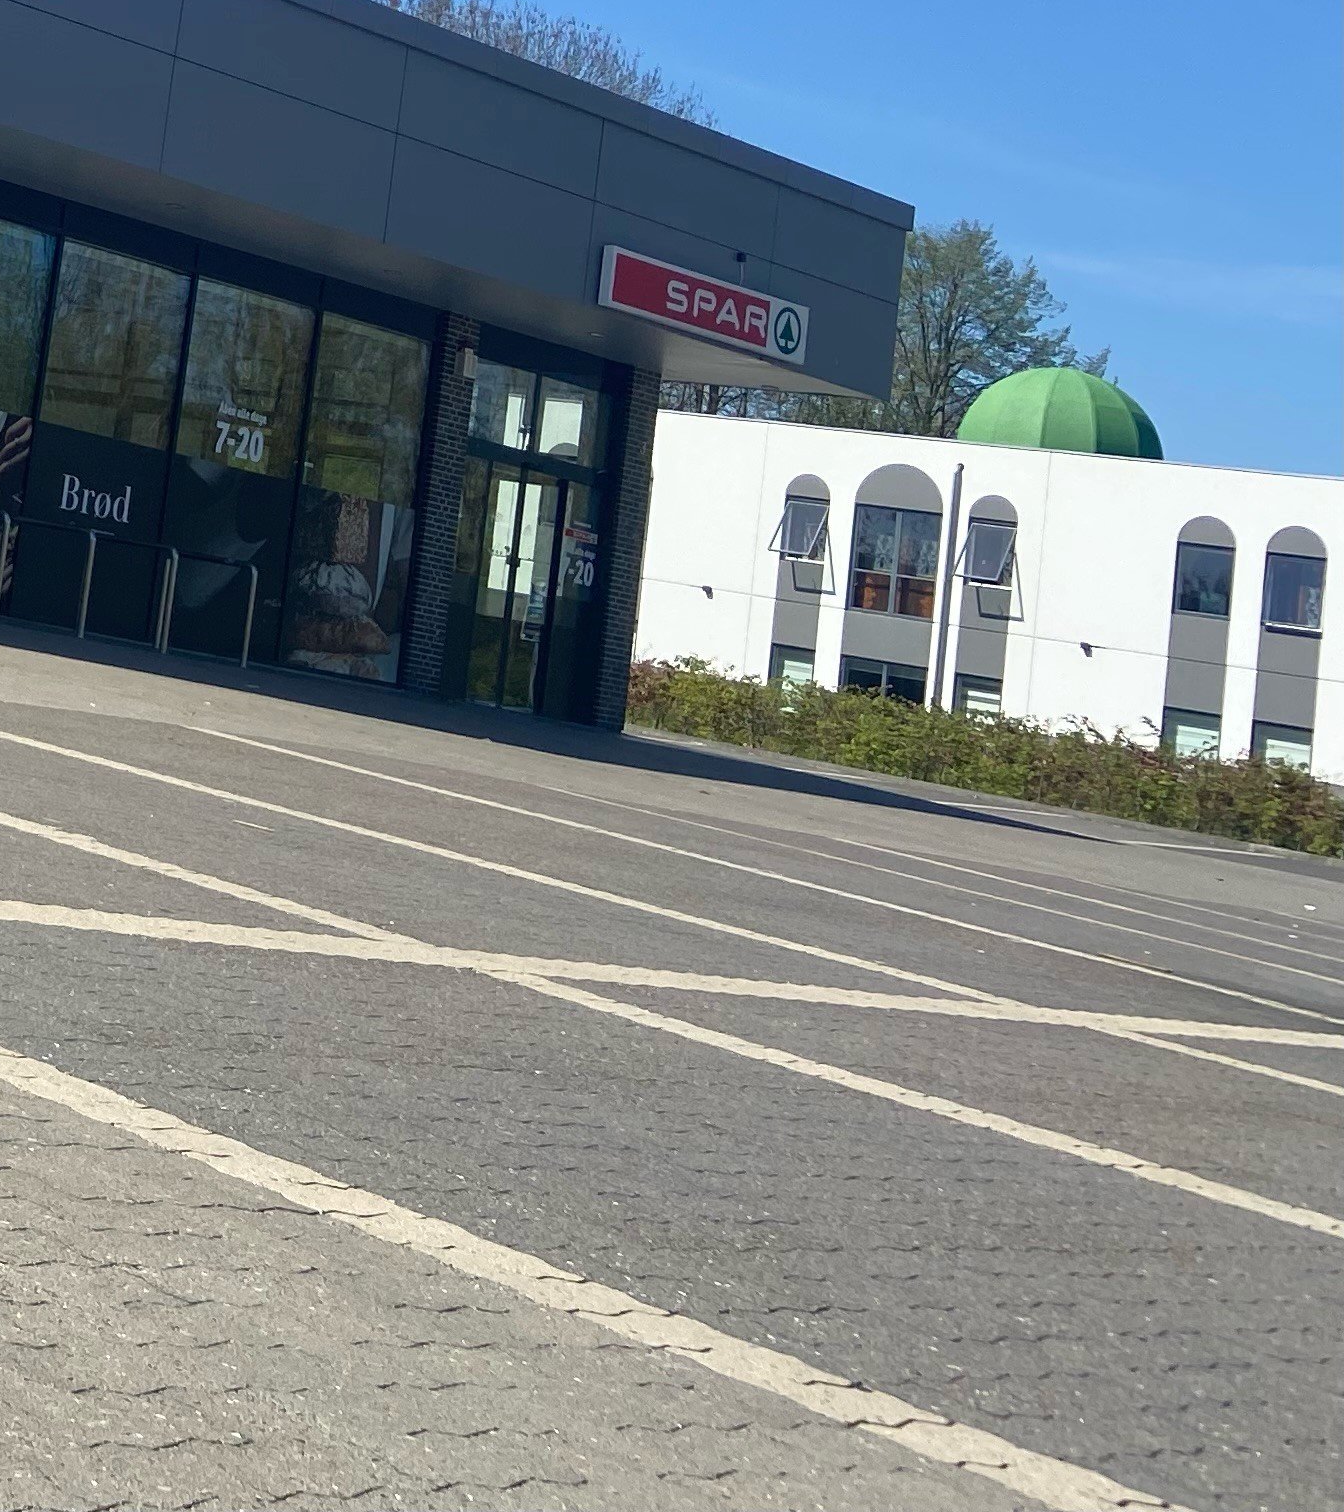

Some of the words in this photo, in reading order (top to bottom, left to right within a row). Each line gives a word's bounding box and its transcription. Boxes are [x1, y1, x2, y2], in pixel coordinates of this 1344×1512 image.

[665, 279, 768, 339] SPAR
[215, 420, 264, 463] 7-20
[59, 473, 132, 524] Brød
